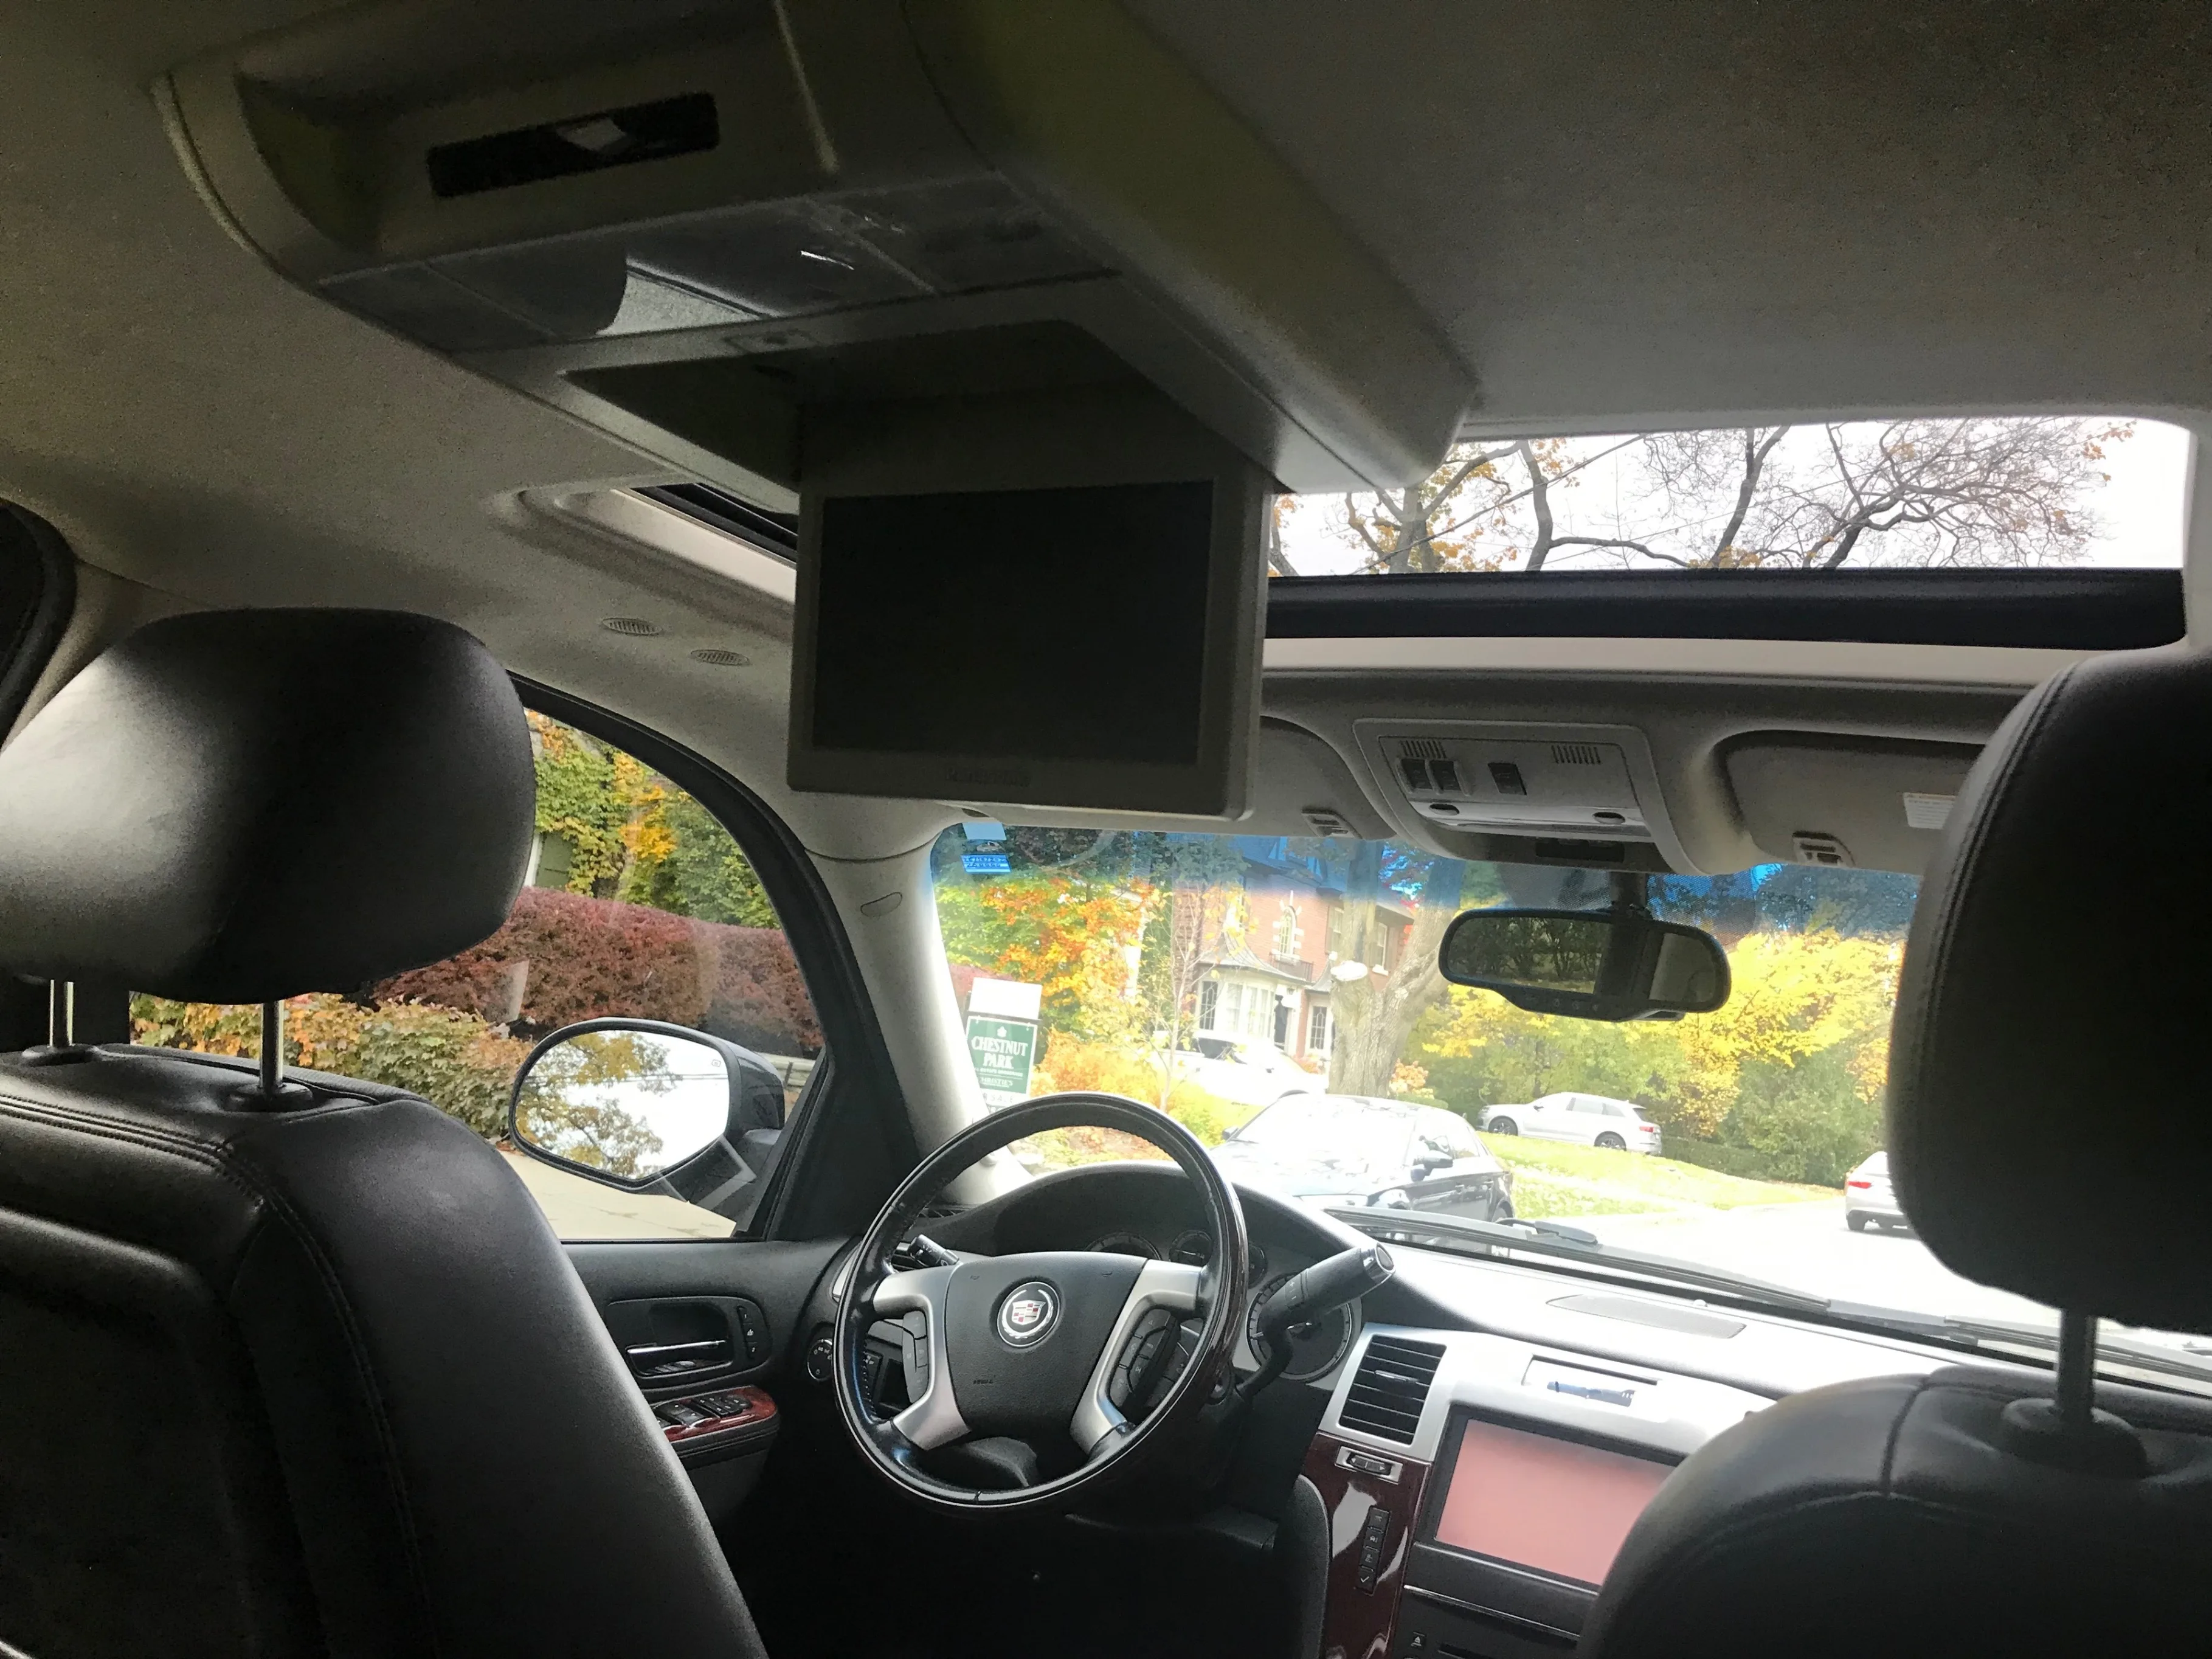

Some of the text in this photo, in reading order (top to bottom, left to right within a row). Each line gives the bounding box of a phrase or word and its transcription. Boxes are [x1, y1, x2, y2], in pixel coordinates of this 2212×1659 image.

[971, 1036, 1028, 1056] CHESTNUT
[983, 1052, 1014, 1069] PARK
[990, 1093, 1014, 1104] SAE
